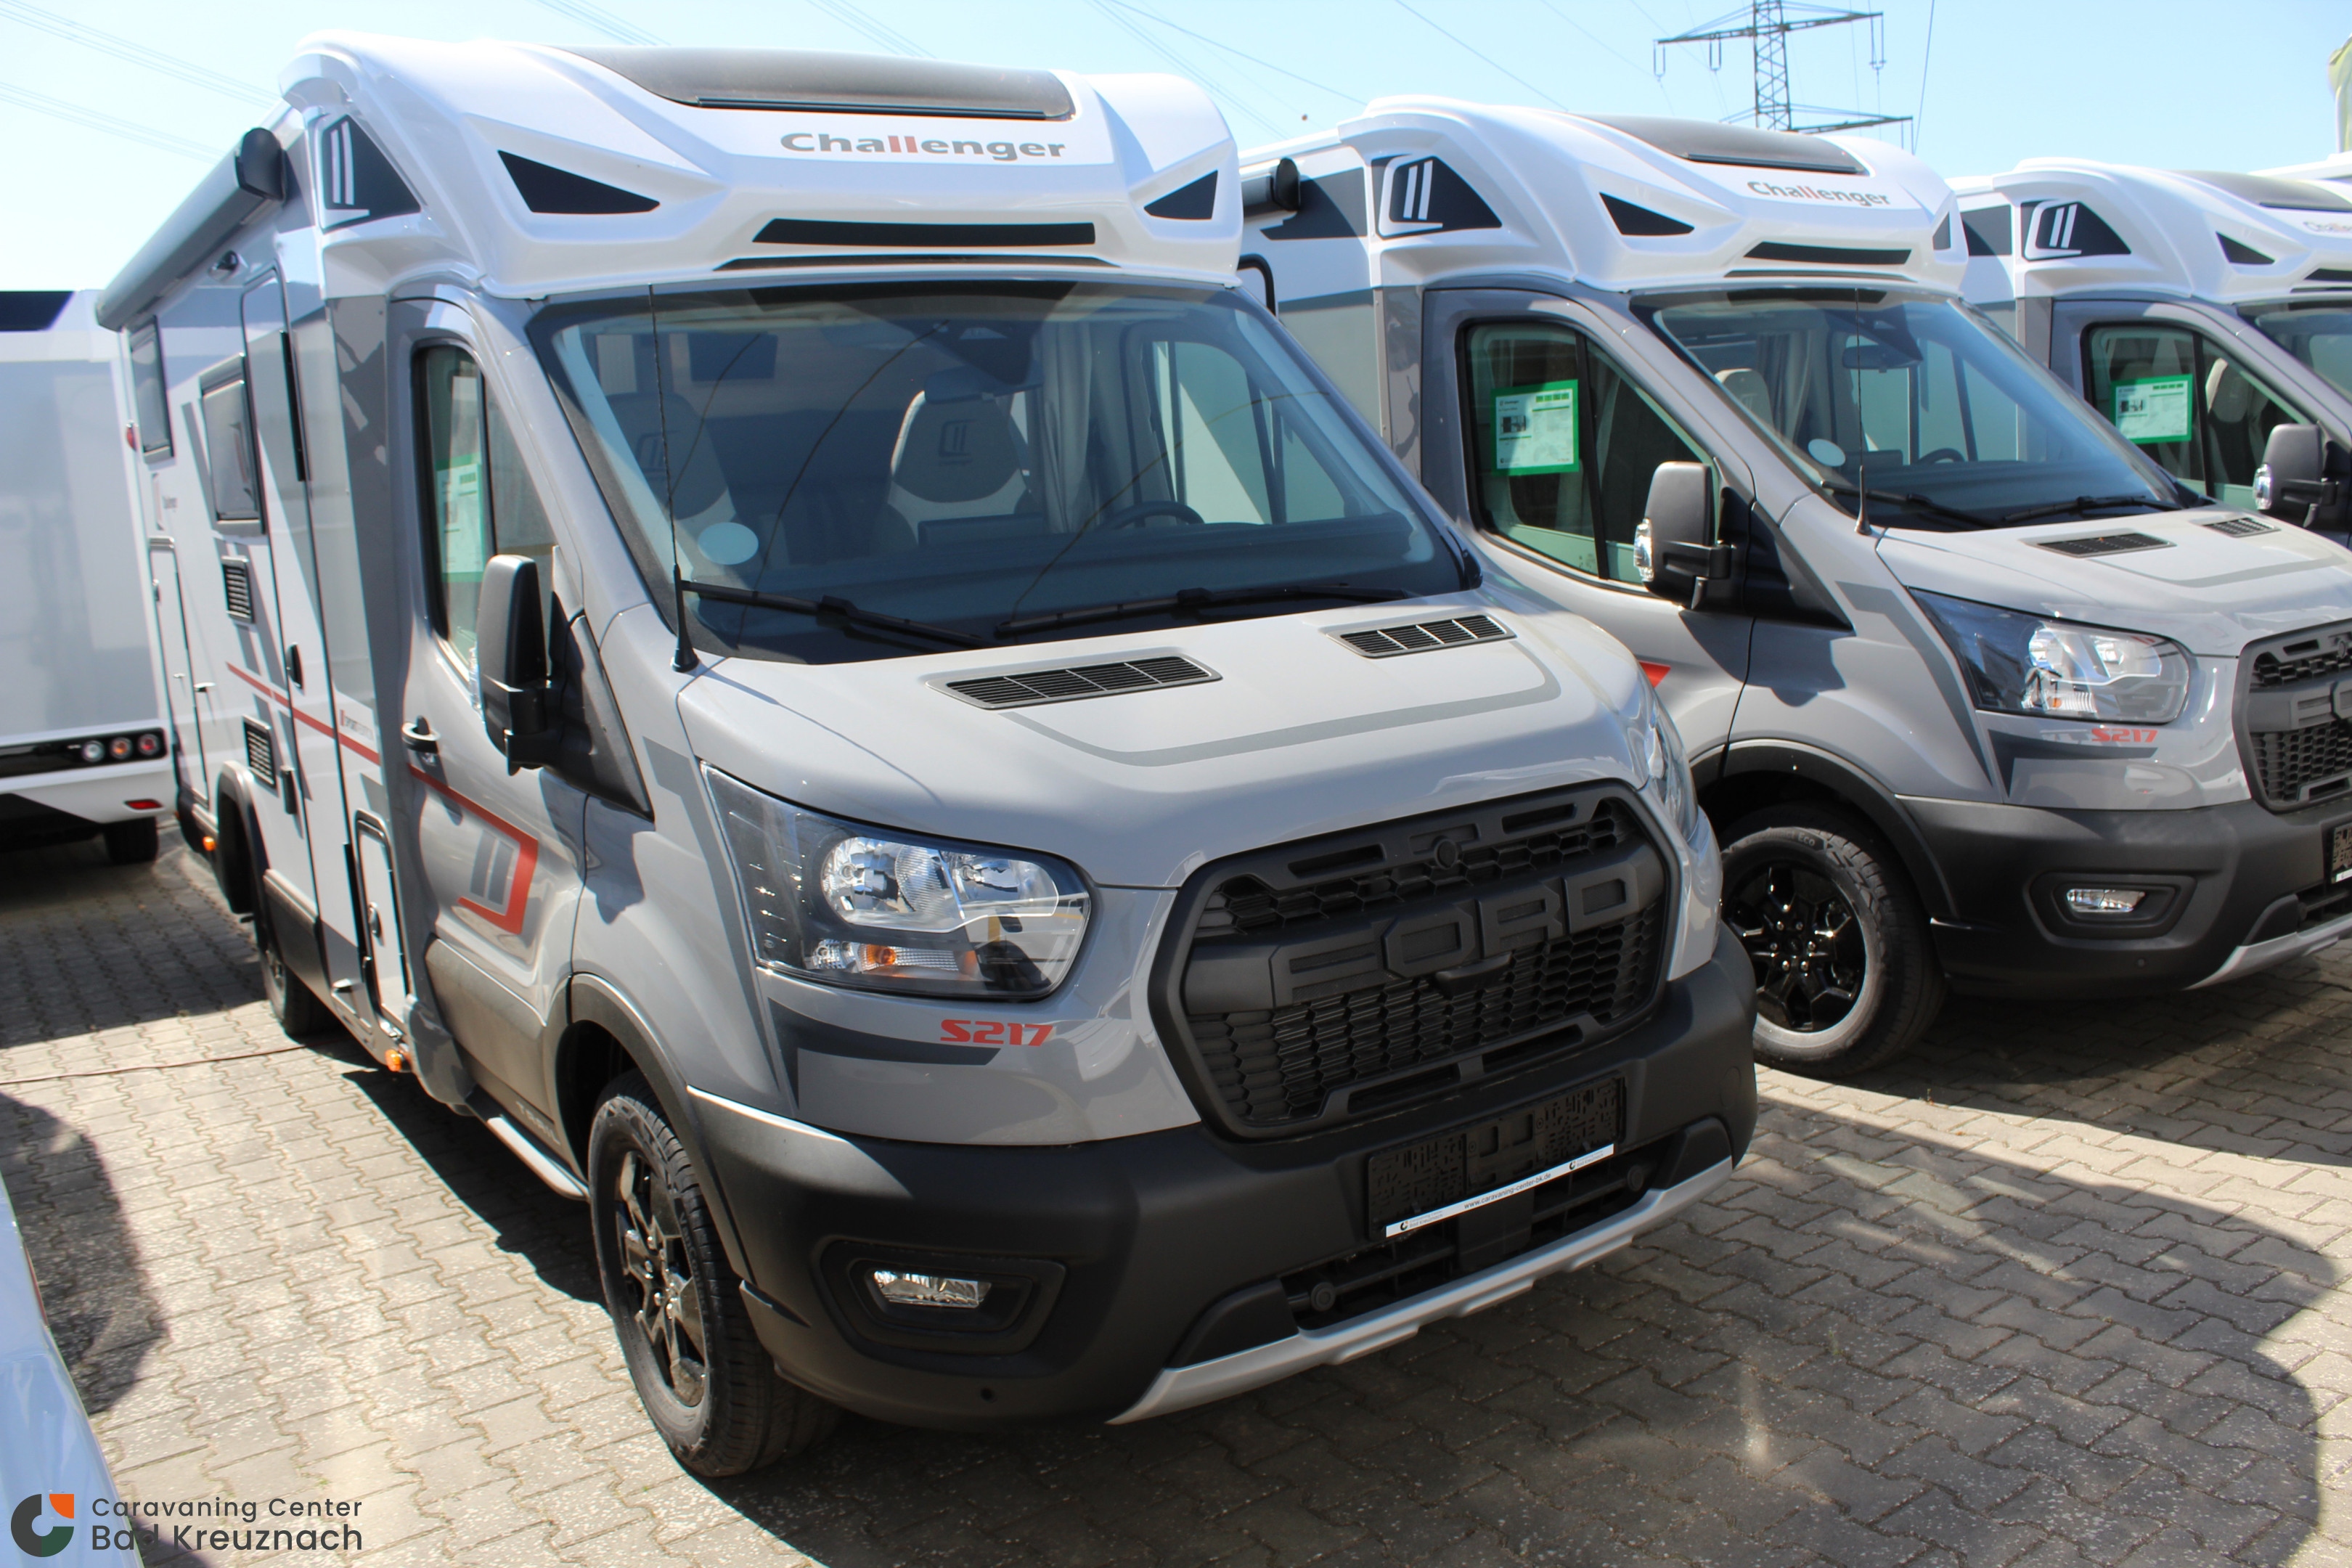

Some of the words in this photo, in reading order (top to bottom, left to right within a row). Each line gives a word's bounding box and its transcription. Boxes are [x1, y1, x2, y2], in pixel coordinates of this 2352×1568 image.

[780, 132, 1066, 161] Challenger
[1747, 181, 1890, 207] Challenger
[2091, 727, 2158, 743] S217
[1269, 859, 1639, 1011] FORD
[940, 1018, 1054, 1047] S217
